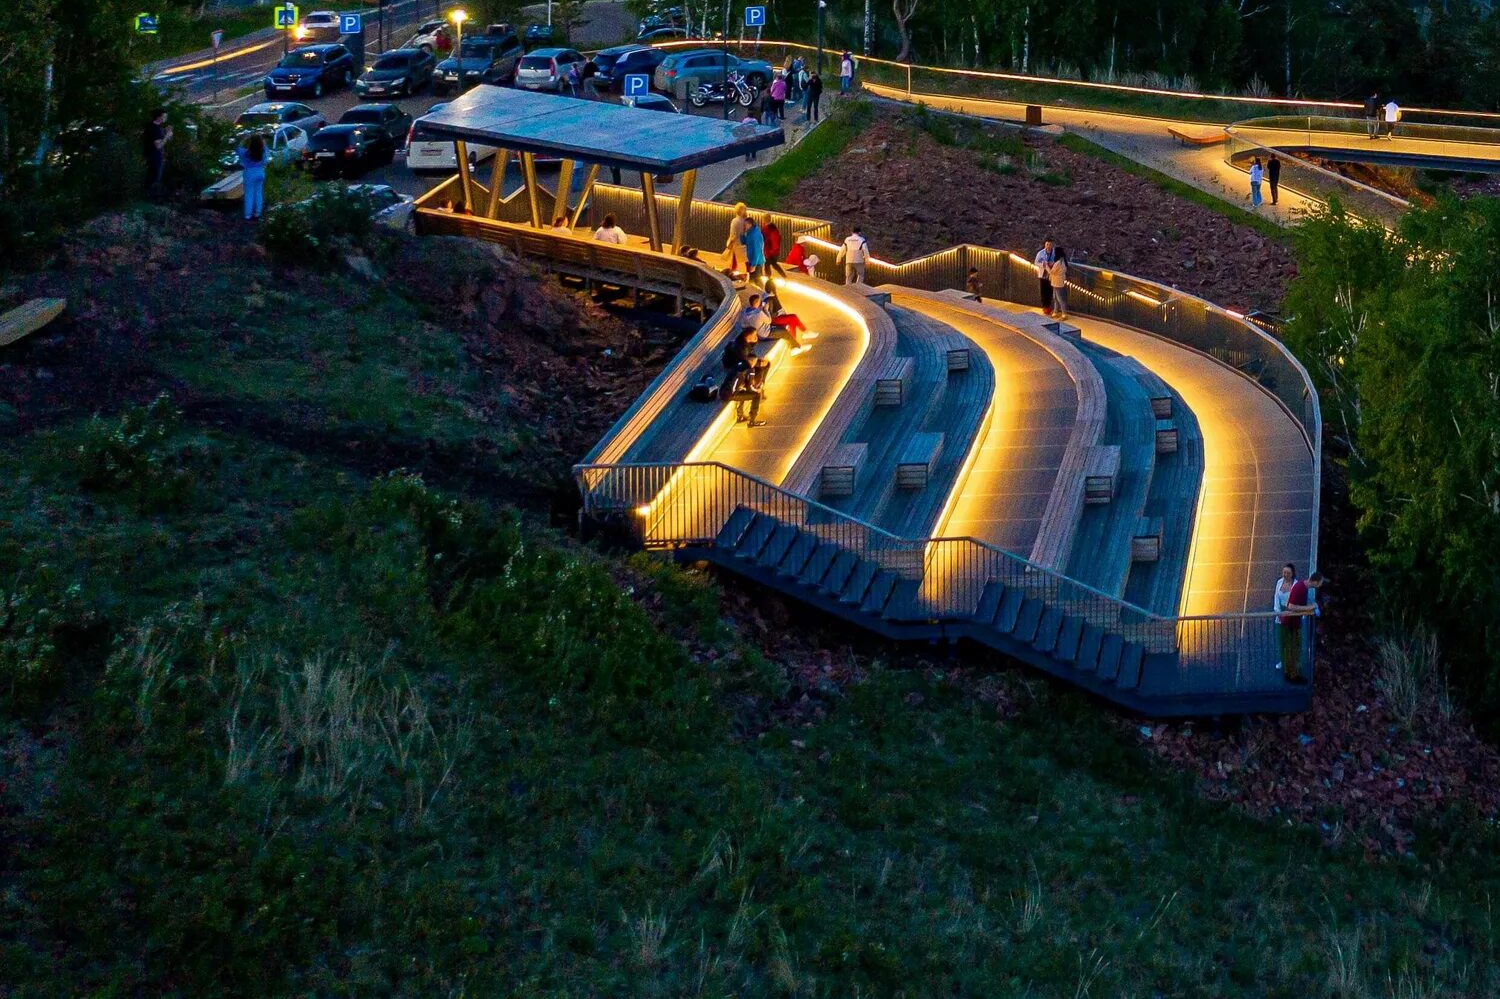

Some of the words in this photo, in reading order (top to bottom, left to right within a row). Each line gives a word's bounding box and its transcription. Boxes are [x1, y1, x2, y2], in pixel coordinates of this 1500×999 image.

[751, 10, 761, 23] P
[345, 17, 356, 30] P
[632, 78, 643, 94] P
